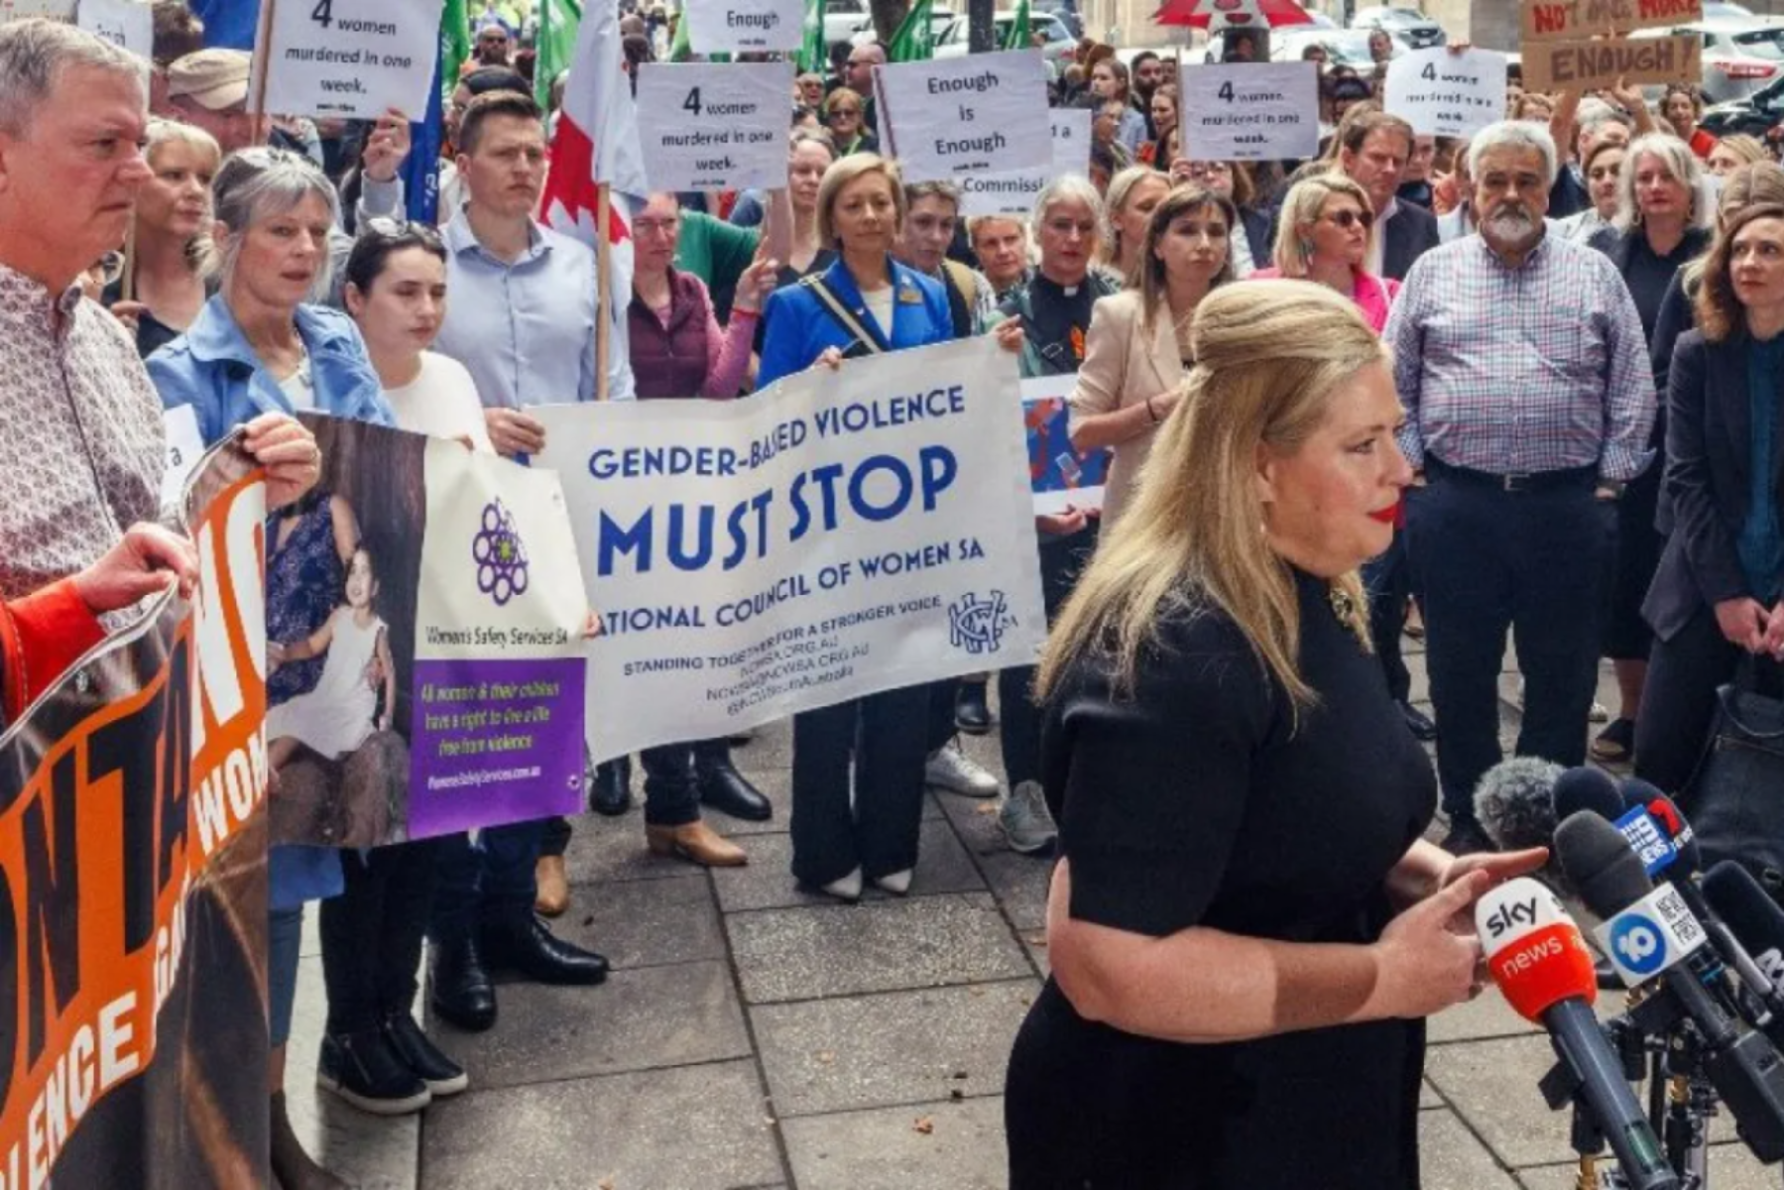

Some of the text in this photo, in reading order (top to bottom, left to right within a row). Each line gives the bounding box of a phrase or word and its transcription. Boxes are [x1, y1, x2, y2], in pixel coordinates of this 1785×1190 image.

[311, 0, 397, 35] 4 women
[727, 10, 780, 30] Enough
[285, 47, 412, 68] murdered in one
[927, 70, 999, 94] Enough
[1421, 62, 1437, 81] 4
[320, 78, 367, 94] week.
[1218, 81, 1235, 102] 4
[683, 86, 757, 116] 4 women
[959, 104, 975, 121] is
[661, 130, 773, 146] murdered in one
[935, 131, 1006, 155] Enough
[696, 155, 737, 170] week.
[963, 177, 1044, 193] Commissi
[588, 385, 965, 479] GENDER-BASED VIOLENCE
[597, 444, 958, 577] MUST STOP
[597, 537, 985, 638] ATIONAL COUNCIL OF WOMEN SA
[426, 625, 568, 649] Women's Safety Services SA
[624, 595, 942, 676] STANDING TOGETHER FOR A STRONGER VOICE
[1487, 896, 1536, 938] sky
[1502, 936, 1564, 979] news
